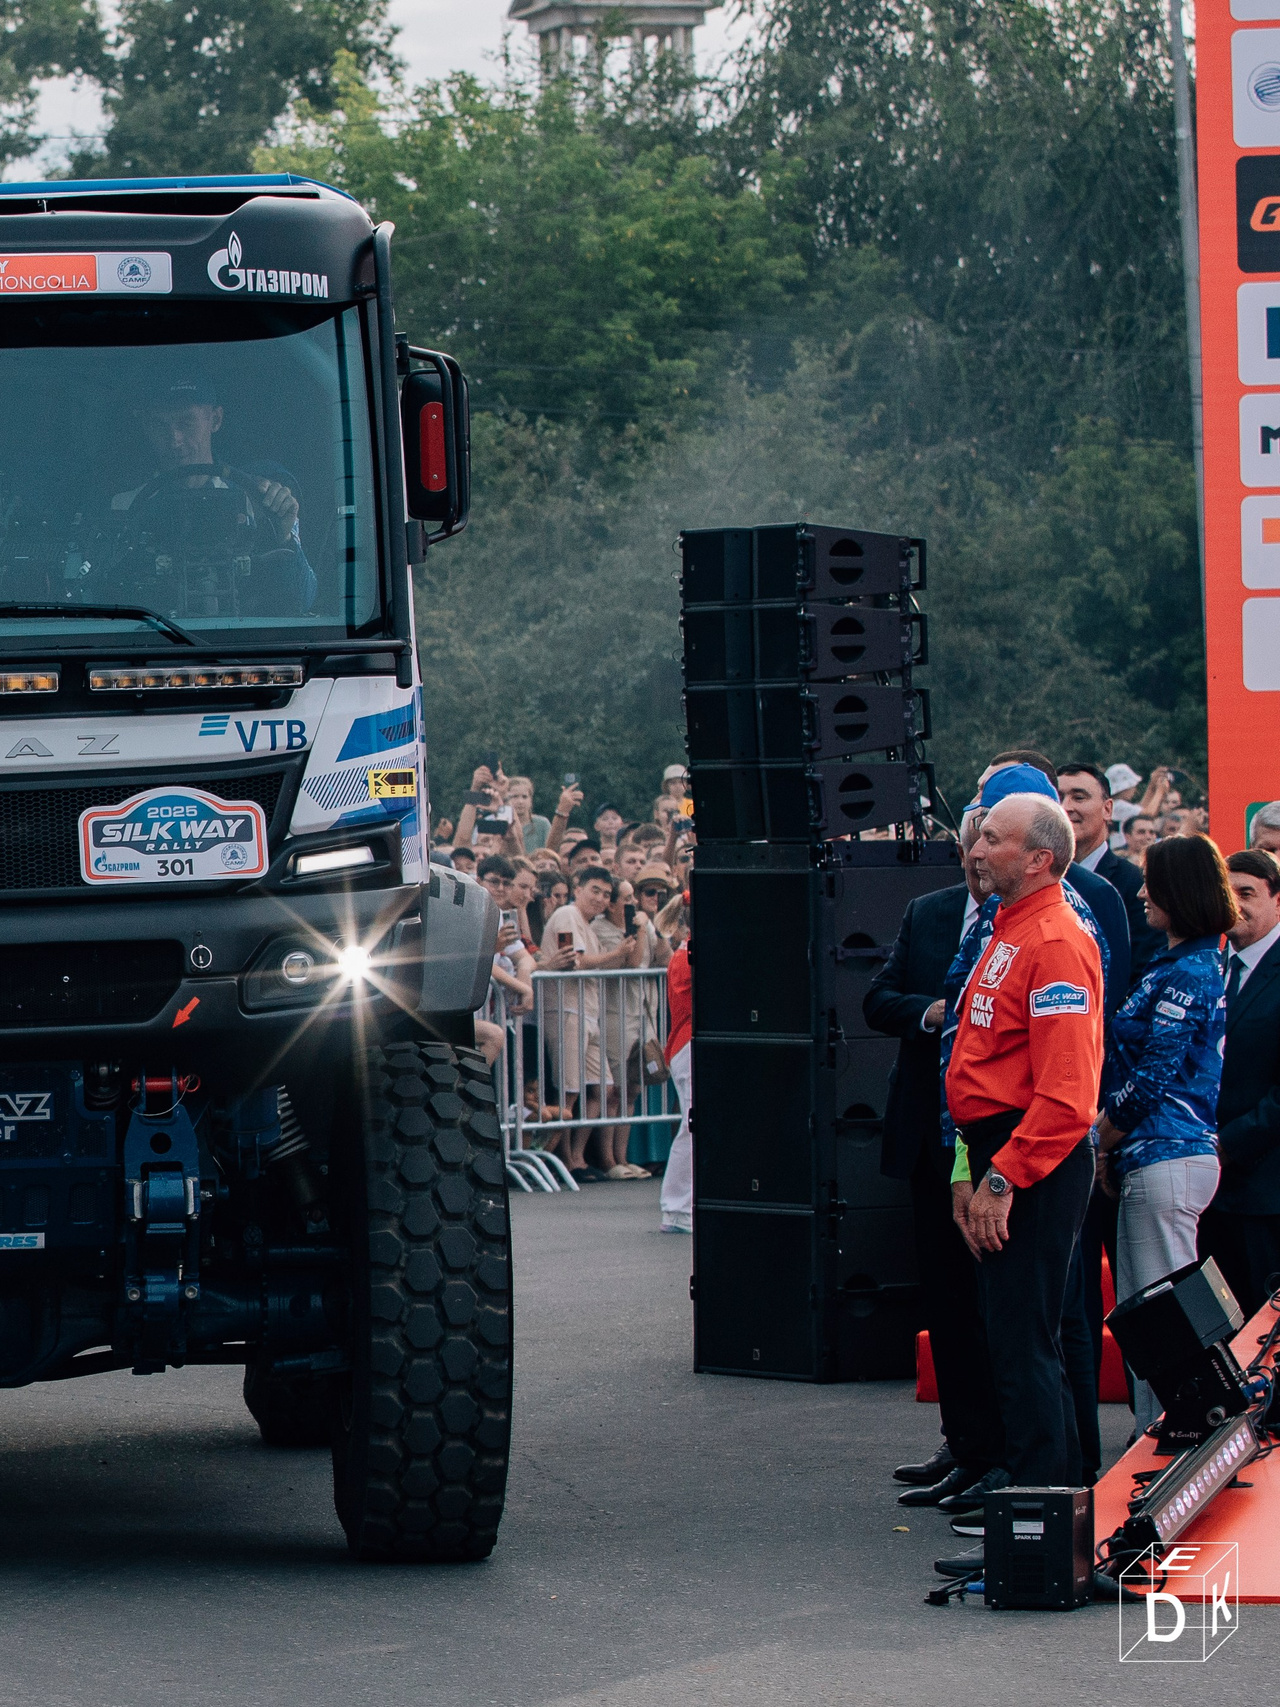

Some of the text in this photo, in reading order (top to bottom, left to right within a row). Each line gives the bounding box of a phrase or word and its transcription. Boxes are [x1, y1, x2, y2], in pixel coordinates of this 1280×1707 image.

[247, 268, 329, 299] ГАЗПРОМ
[234, 719, 309, 753] VTB
[147, 805, 197, 818] 2025
[100, 819, 245, 843] SILK WAY
[145, 841, 203, 851] RALLY
[108, 862, 140, 872] GAZPROM
[157, 859, 194, 876] 301
[971, 992, 995, 1012] SILK
[1035, 993, 1084, 1004] SILK WAY
[1172, 986, 1193, 1006] VTB
[970, 1009, 994, 1028] WAY
